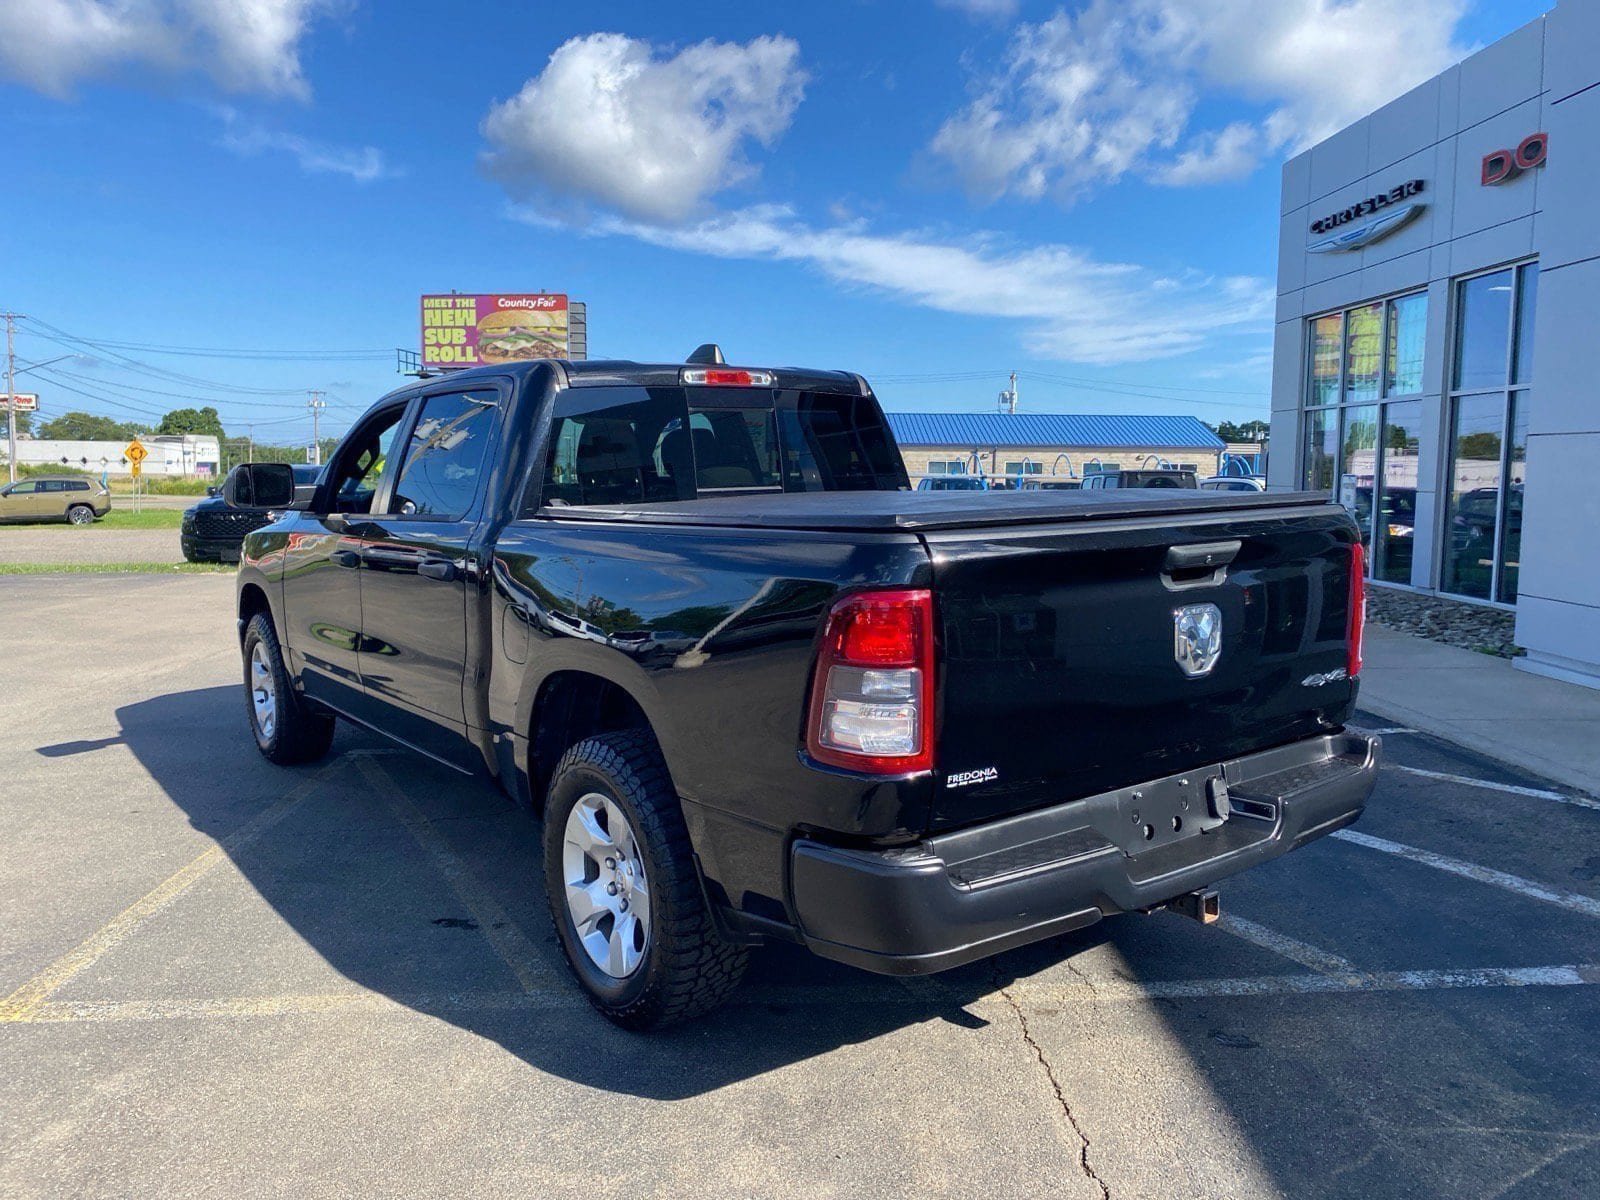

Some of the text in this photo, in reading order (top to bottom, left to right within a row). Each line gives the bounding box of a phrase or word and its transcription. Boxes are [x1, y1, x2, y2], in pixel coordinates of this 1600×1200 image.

[1309, 179, 1425, 234] CHRYSLER
[424, 298, 476, 309] MEET THE
[498, 296, 557, 309] Country Fair
[424, 309, 477, 327] NEW
[424, 328, 467, 345] SUB
[424, 346, 478, 363] ROLL
[947, 767, 998, 784] FREDONIA
